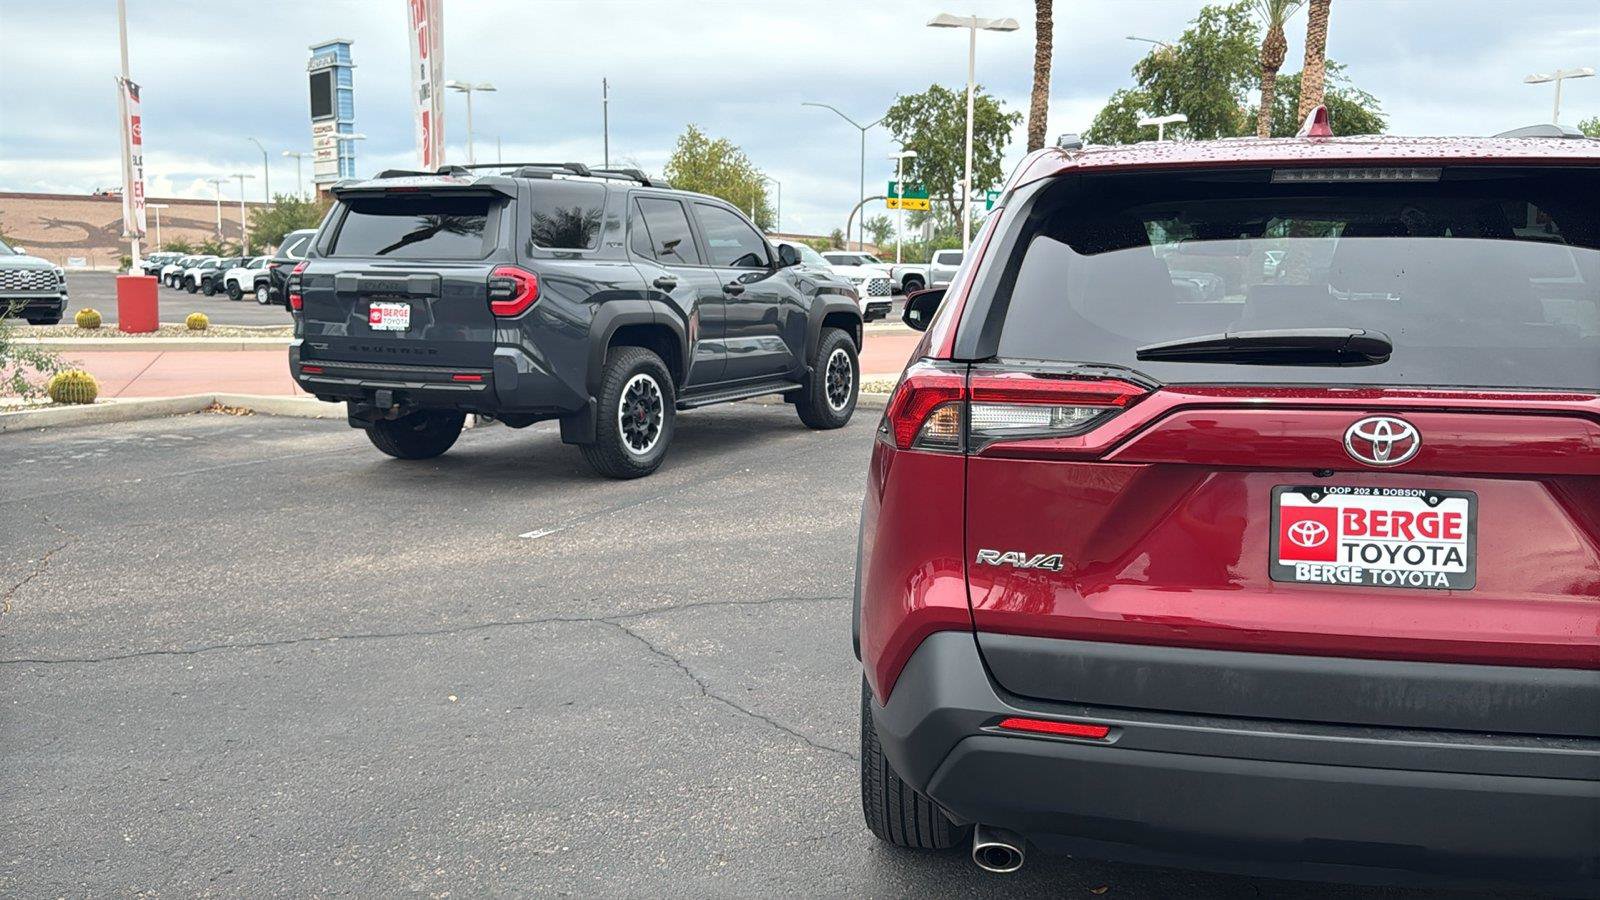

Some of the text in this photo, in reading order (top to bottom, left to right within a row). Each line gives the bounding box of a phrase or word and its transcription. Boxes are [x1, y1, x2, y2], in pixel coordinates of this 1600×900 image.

[383, 308, 408, 318] BERGE
[383, 318, 409, 326] TOYOTA
[1323, 487, 1426, 498] LOOP 202 & DOBSON
[1342, 508, 1463, 542] BERGE
[975, 549, 1064, 572] RAV4
[1342, 543, 1464, 567] TOYOTA
[1295, 562, 1450, 588] BERGE TOYOTA
